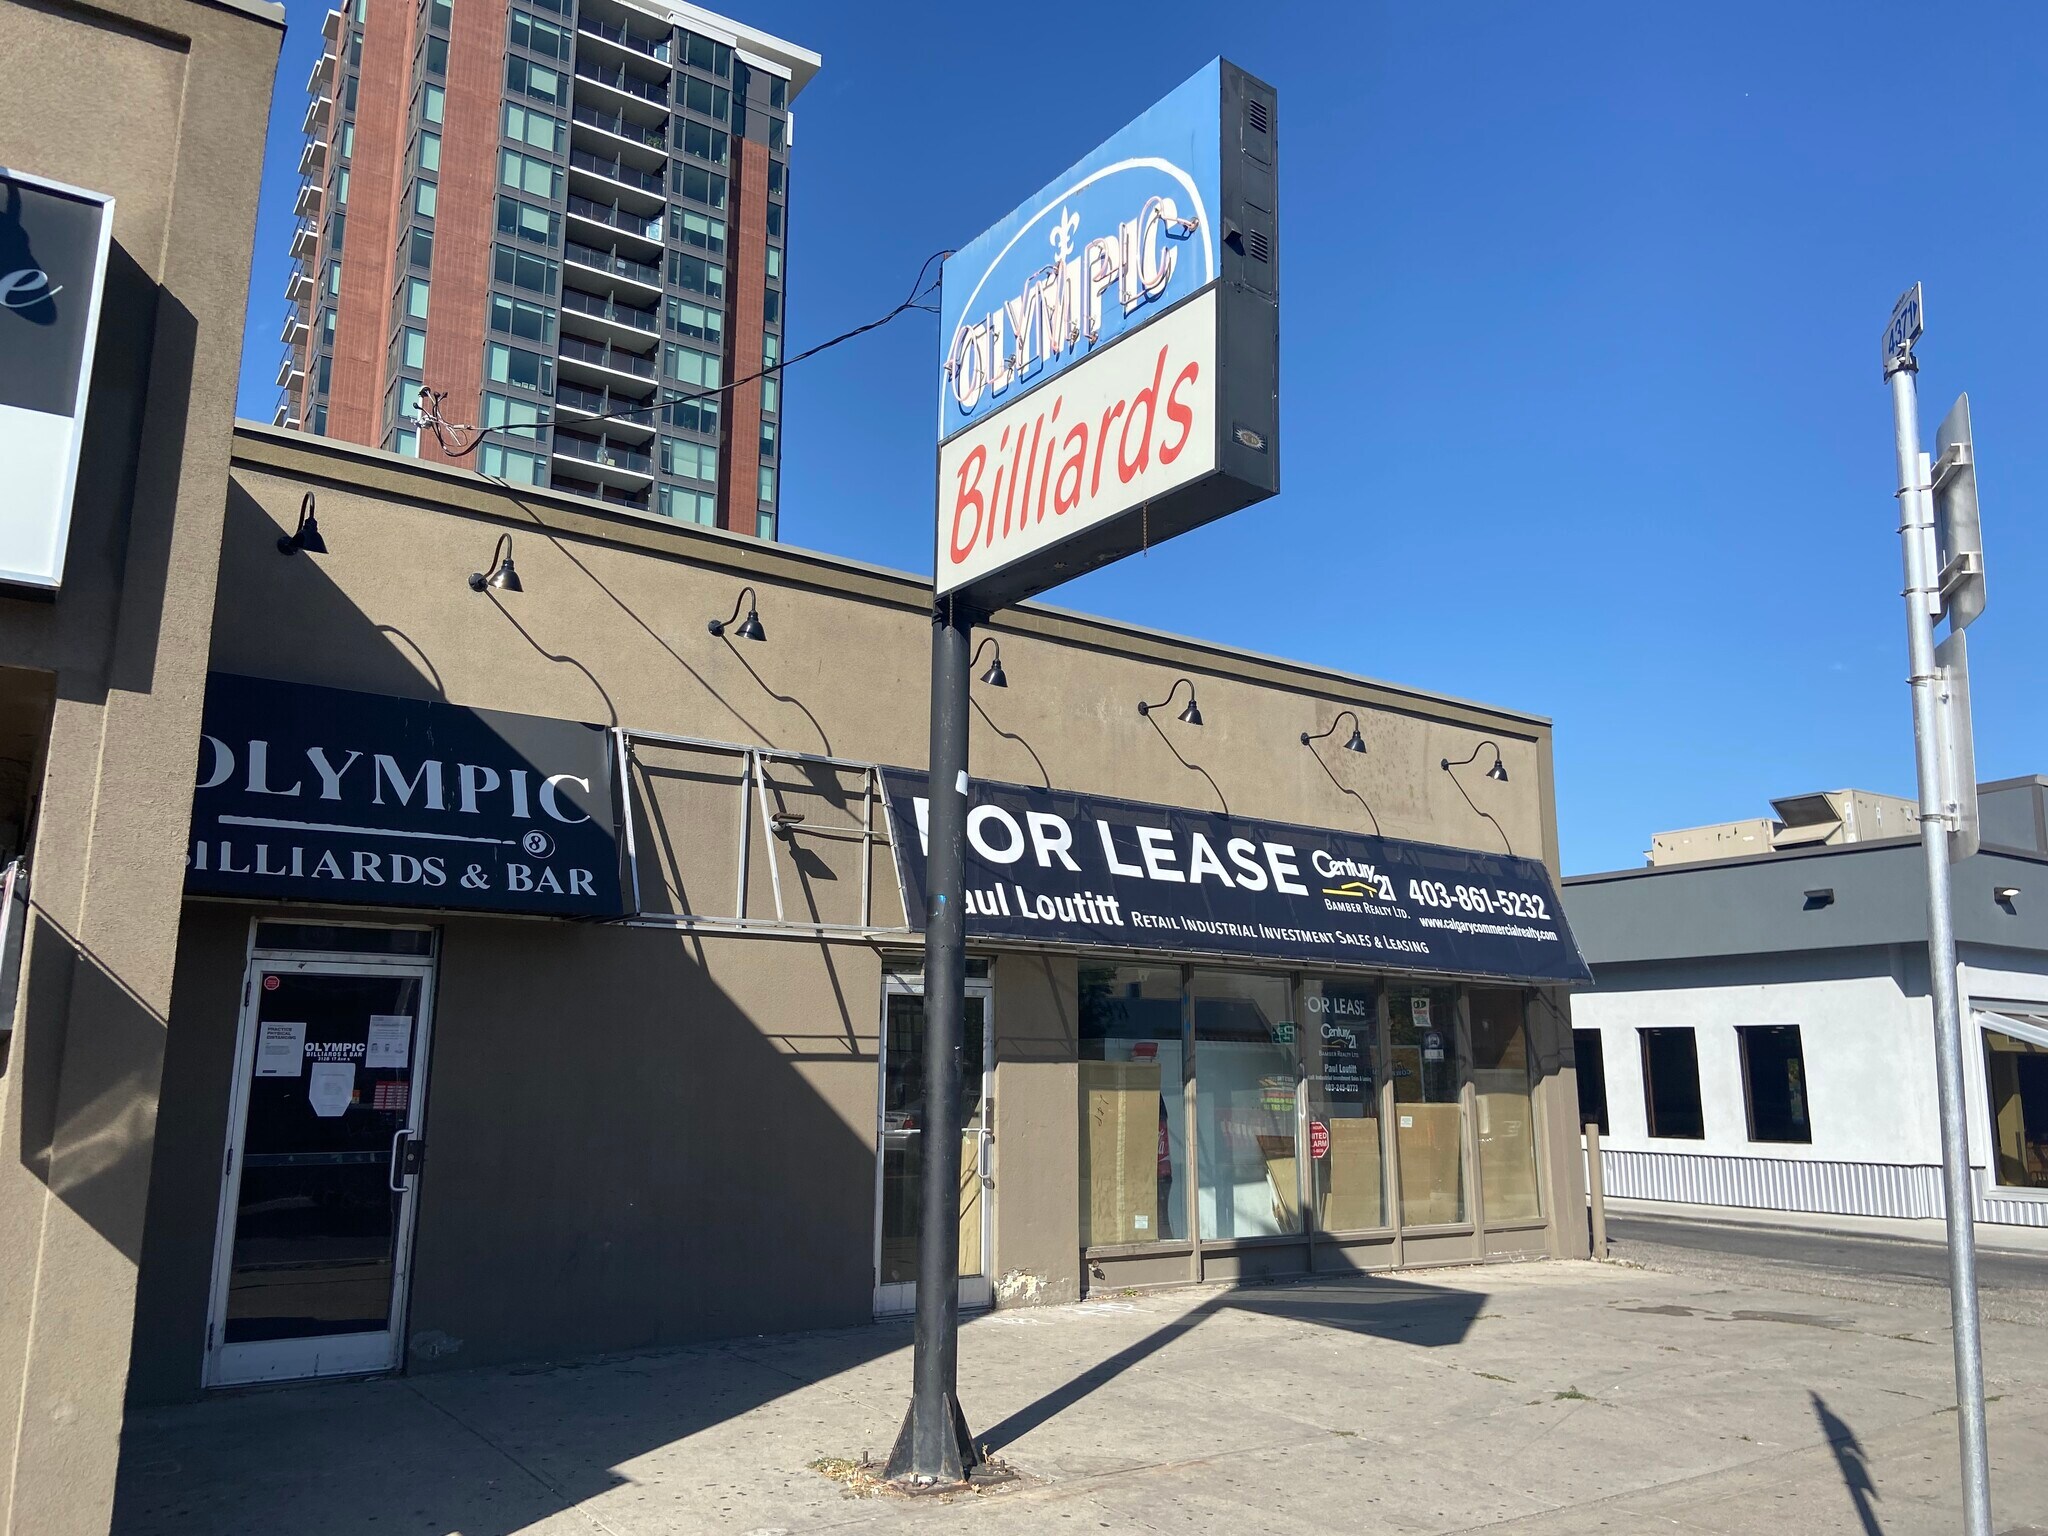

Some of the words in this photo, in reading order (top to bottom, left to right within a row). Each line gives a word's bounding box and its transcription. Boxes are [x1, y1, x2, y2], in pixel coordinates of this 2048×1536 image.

[946, 196, 1190, 409] OLYMPIC
[949, 344, 1199, 564] Billiards
[185, 841, 447, 887] ILLIARDS
[460, 863, 491, 890] &
[507, 862, 598, 897] BAR
[1096, 819, 1310, 897] LEASE
[1311, 848, 1376, 883] Century
[1373, 874, 1398, 902] 21
[964, 882, 1011, 917] aul
[1014, 884, 1125, 928] Loutitt
[1132, 911, 1180, 931] RETAIL
[1180, 915, 1258, 939] INDUSTRIAL
[1258, 922, 1335, 945] INVESTMENT
[1335, 929, 1373, 948] SALES
[1374, 936, 1383, 949] &
[1382, 935, 1430, 955] LEASING
[1324, 898, 1363, 914] BAMBER
[1363, 902, 1392, 918] REALTY
[1391, 905, 1411, 920] LTD.
[1408, 878, 1552, 921] 403-861-5232
[1418, 915, 1559, 943] www.calgarycommercialrealty.com
[1333, 997, 1366, 1016] LEASE
[304, 1042, 366, 1052] OLYMPIC
[1320, 1022, 1351, 1041] Century
